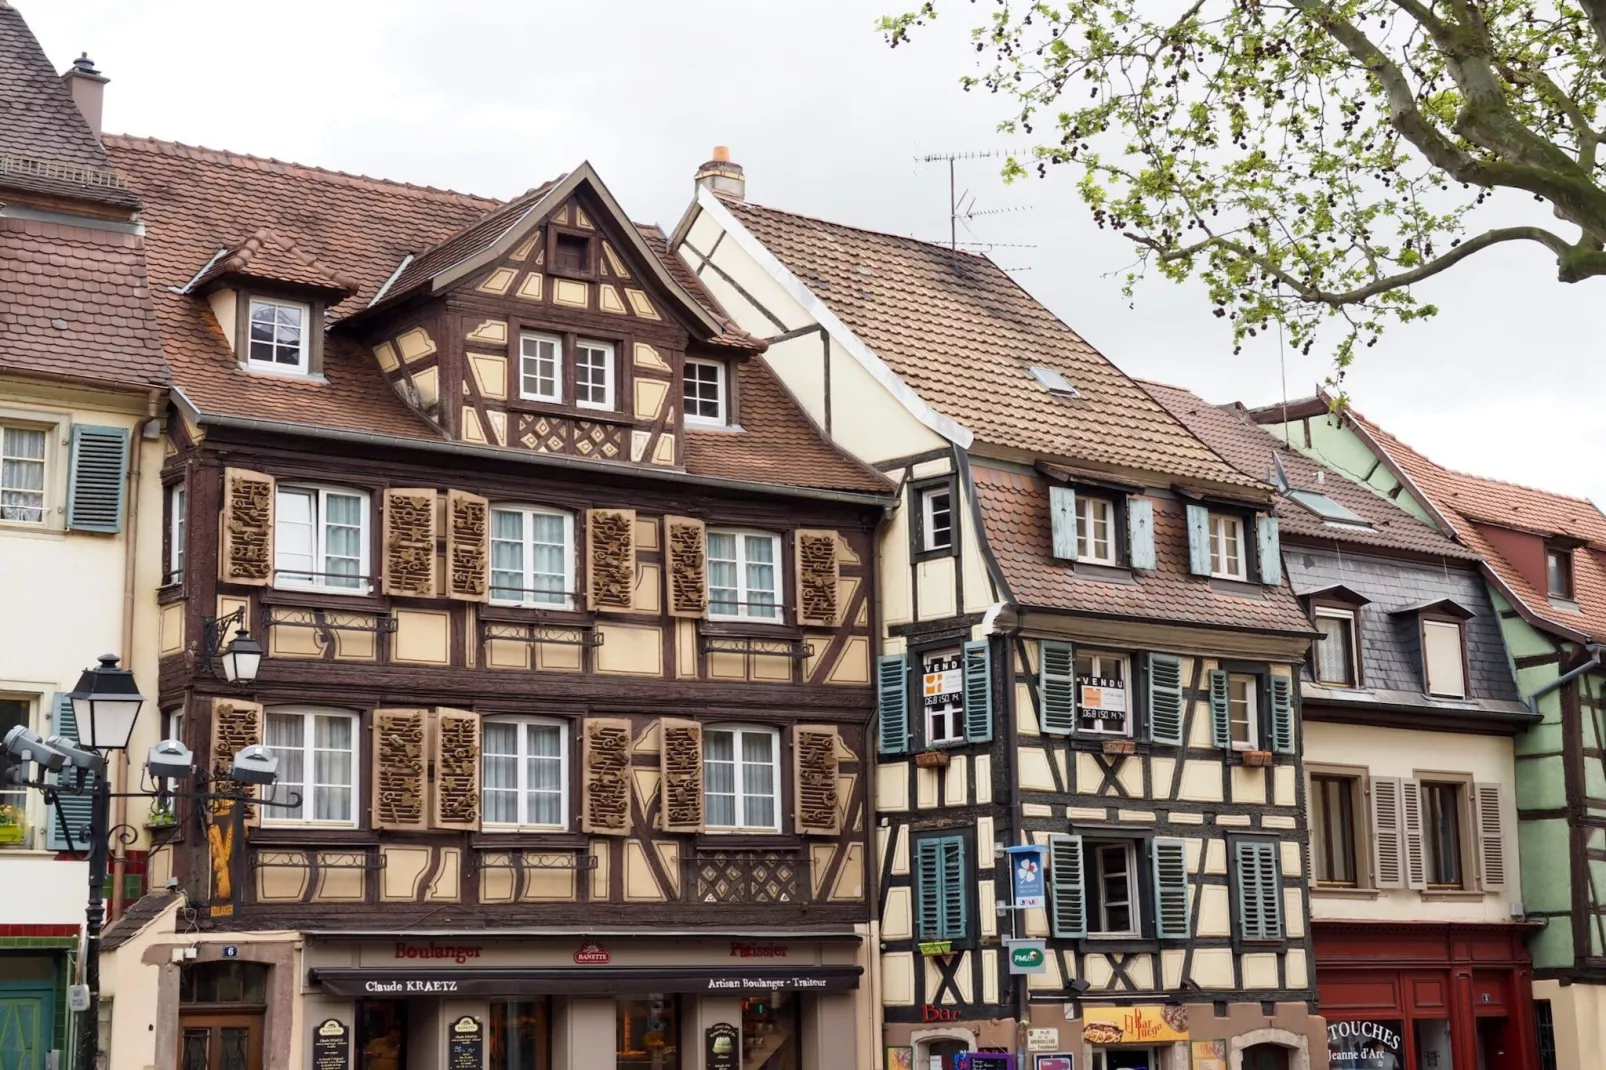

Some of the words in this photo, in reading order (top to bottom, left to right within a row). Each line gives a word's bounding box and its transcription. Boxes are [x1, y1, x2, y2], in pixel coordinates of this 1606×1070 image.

[925, 661, 957, 673] VEND
[1082, 677, 1123, 688] VENDU
[227, 947, 234, 956] 6
[394, 942, 482, 964] Boulanger
[1014, 953, 1031, 962] PMU
[365, 981, 403, 992] Claude
[406, 981, 457, 992] KRAETZ
[708, 979, 740, 989] Artisan
[742, 978, 784, 990] Boulanger
[792, 978, 827, 987] Traiteur
[922, 1004, 961, 1022] Bar
[1327, 1021, 1401, 1050] TOUCHES
[1328, 1049, 1358, 1062] Jeanne
[1360, 1048, 1385, 1059] d'Arc
